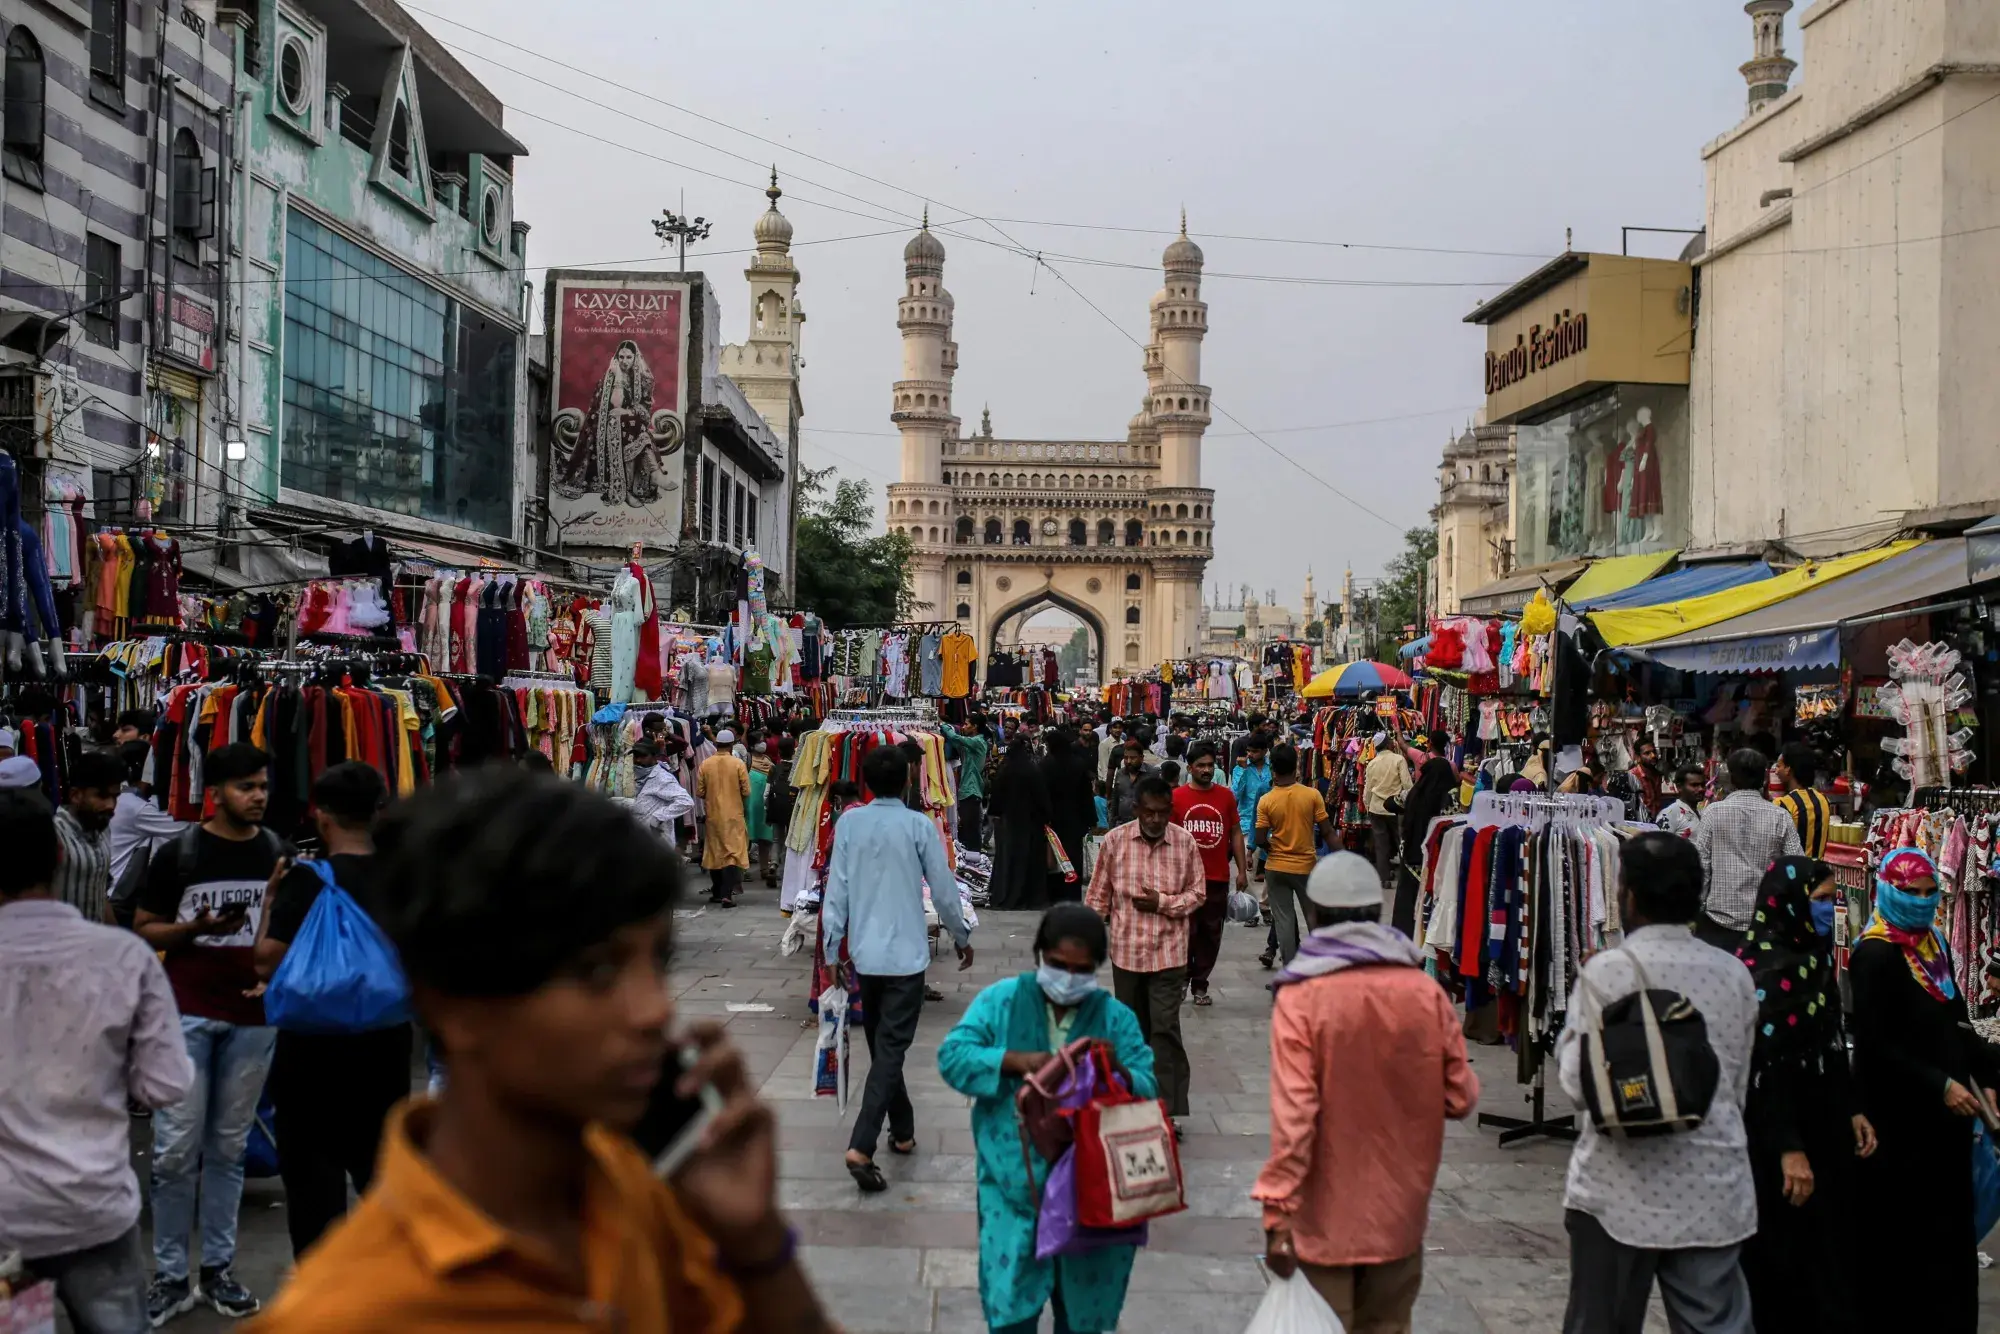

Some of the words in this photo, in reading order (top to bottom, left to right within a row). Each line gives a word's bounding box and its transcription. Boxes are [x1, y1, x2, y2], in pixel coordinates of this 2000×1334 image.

[575, 293, 673, 310] KAYENAT
[1485, 334, 1527, 395] Danub
[1529, 309, 1587, 373] Fashion
